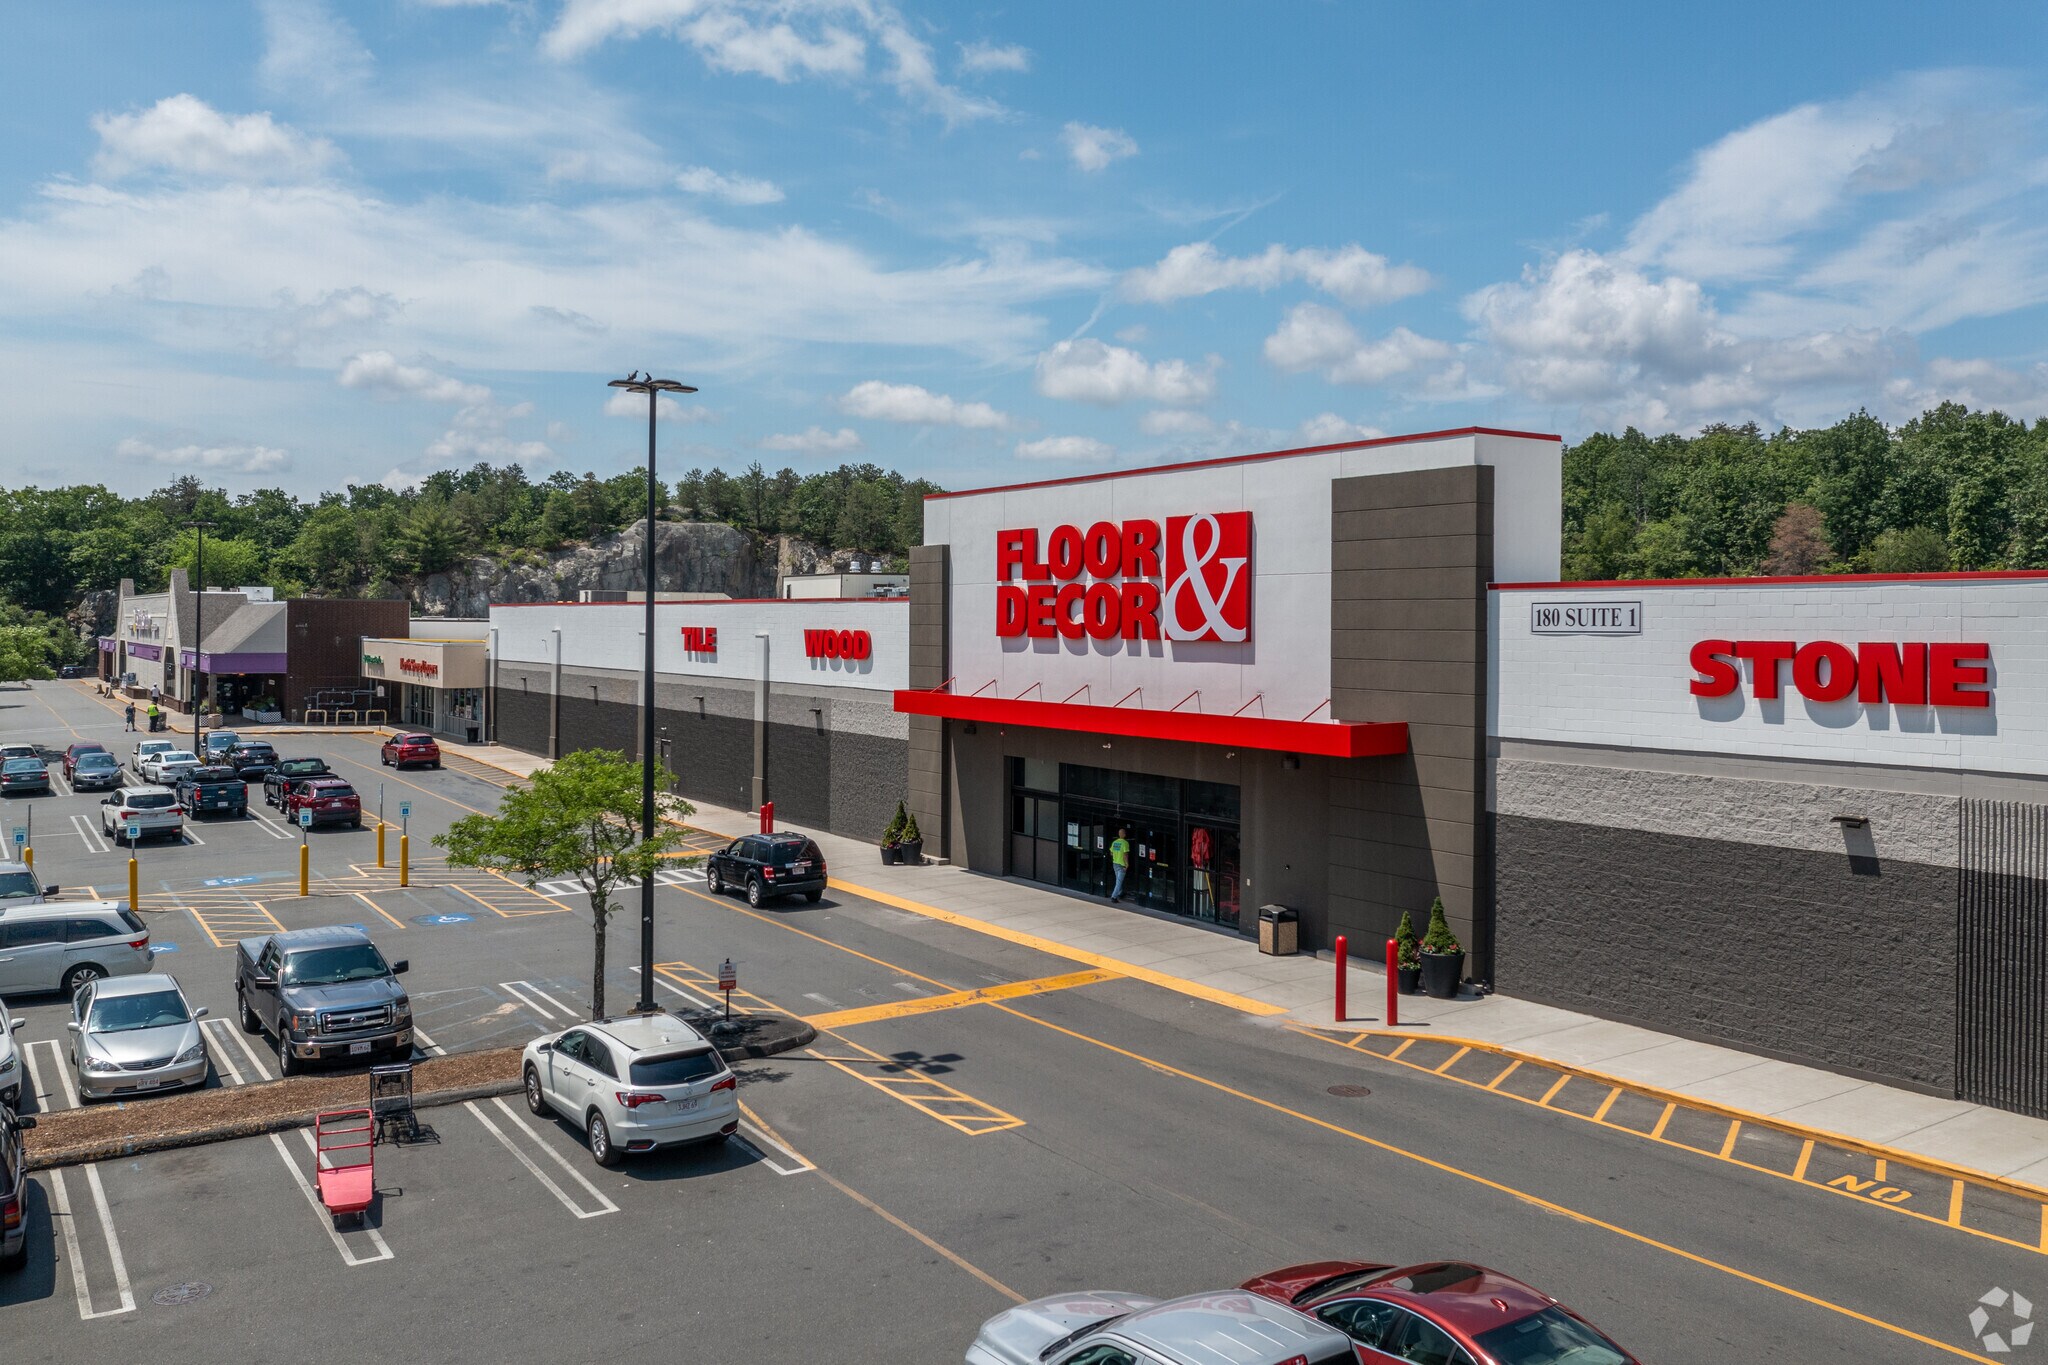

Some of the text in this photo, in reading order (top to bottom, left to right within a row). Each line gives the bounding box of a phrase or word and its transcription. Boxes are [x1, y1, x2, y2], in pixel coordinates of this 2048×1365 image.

[997, 519, 1161, 581] FLOOR
[996, 582, 1162, 640] DECOR
[1536, 608, 1636, 627] 180 SUITE 1
[681, 627, 718, 652] TILE
[804, 629, 872, 660] WOOD
[1689, 639, 1990, 707] STONE
[1826, 1174, 1913, 1203] NO
